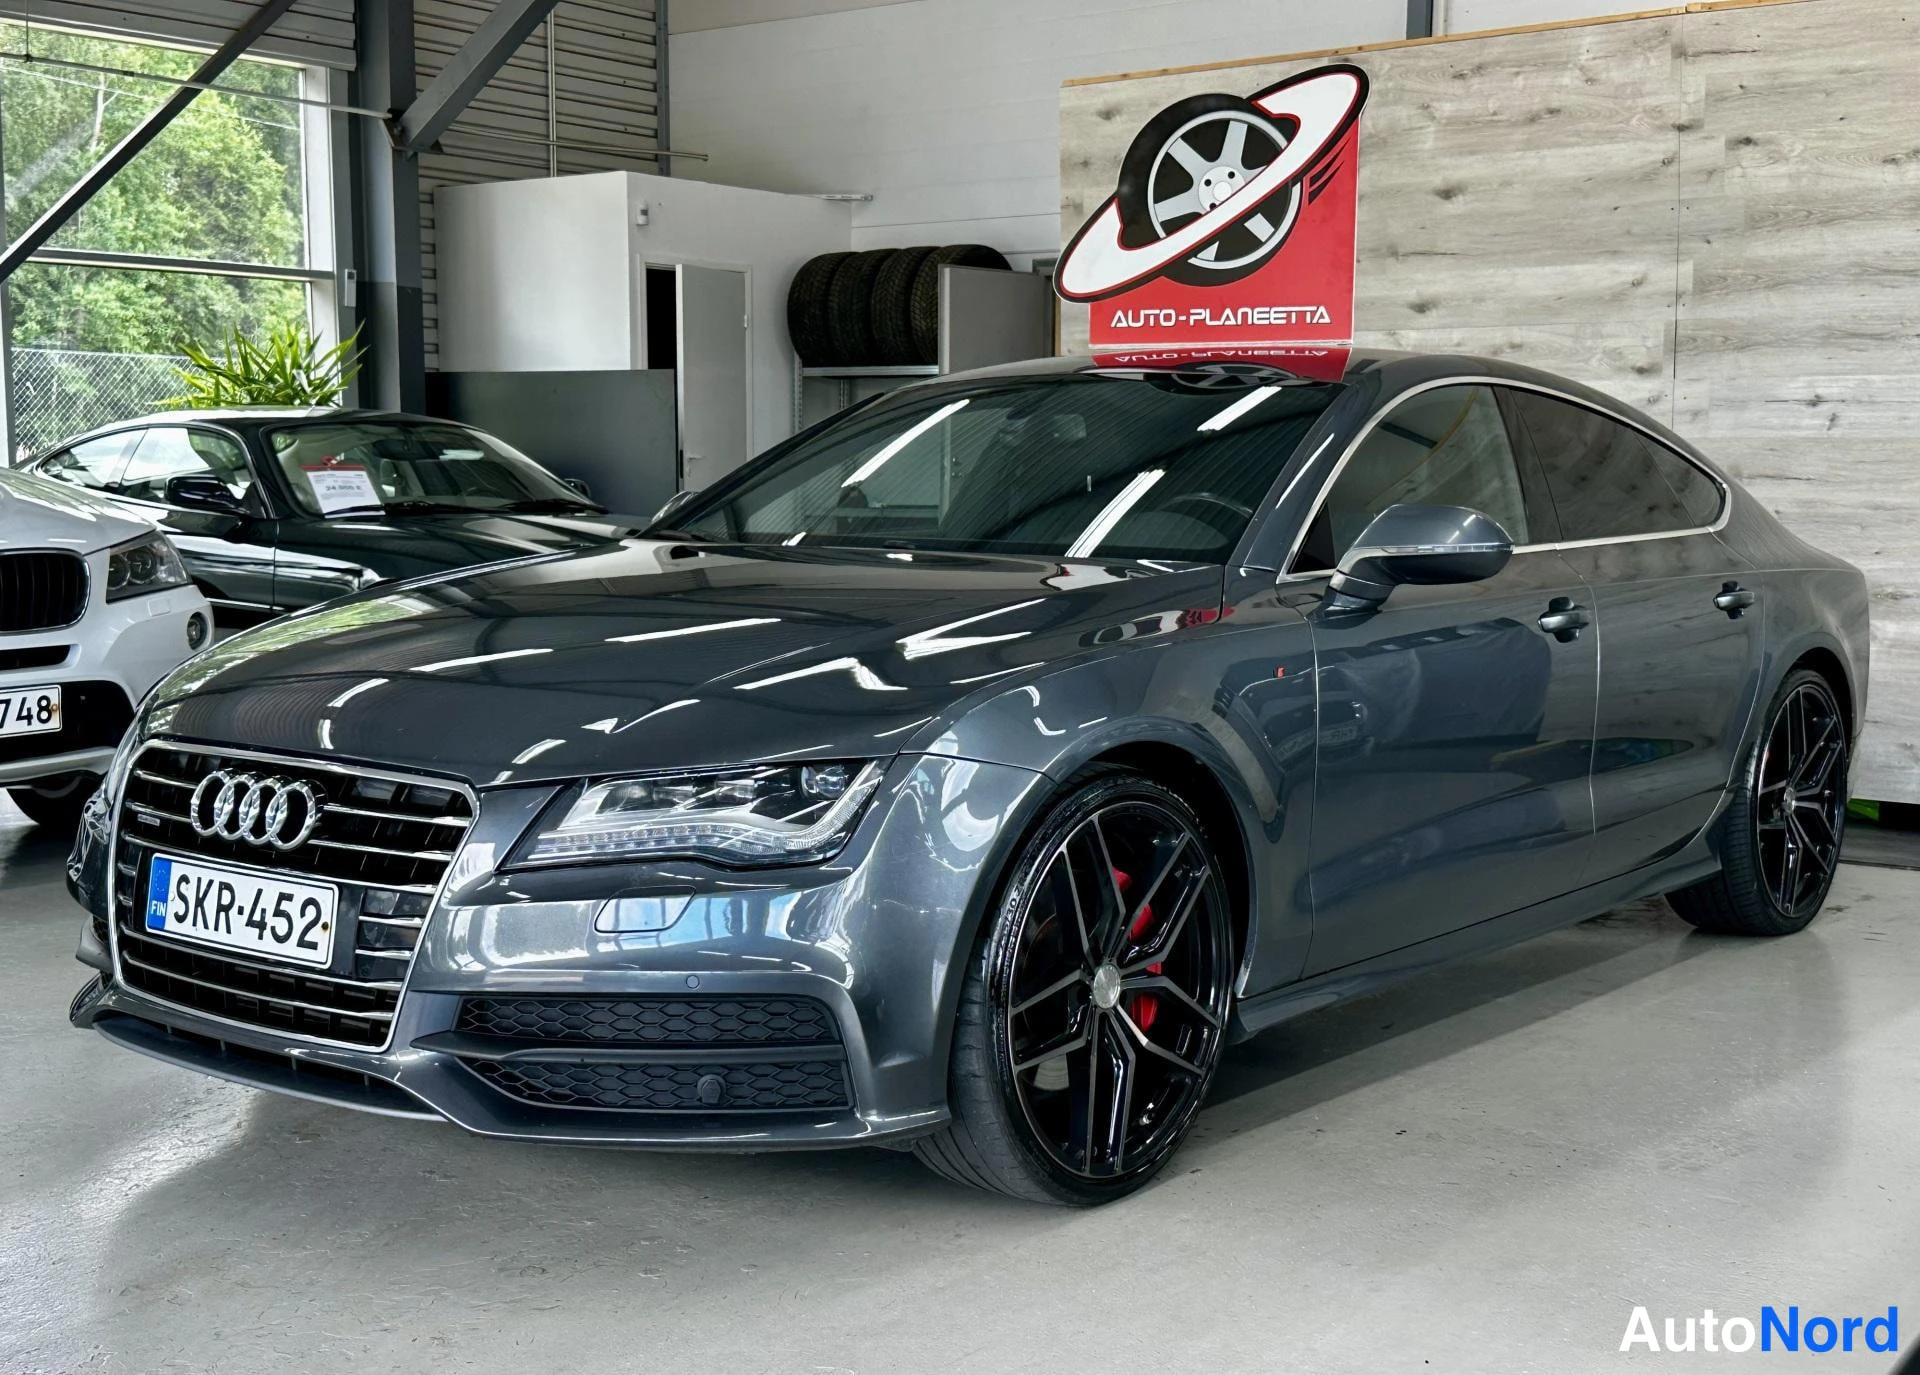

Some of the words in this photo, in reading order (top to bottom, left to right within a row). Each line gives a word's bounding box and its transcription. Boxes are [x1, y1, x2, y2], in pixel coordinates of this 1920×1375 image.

[1110, 306, 1331, 328] AUTO-PLANEETTA
[149, 900, 167, 917] FIN
[173, 873, 322, 950] SKR-452
